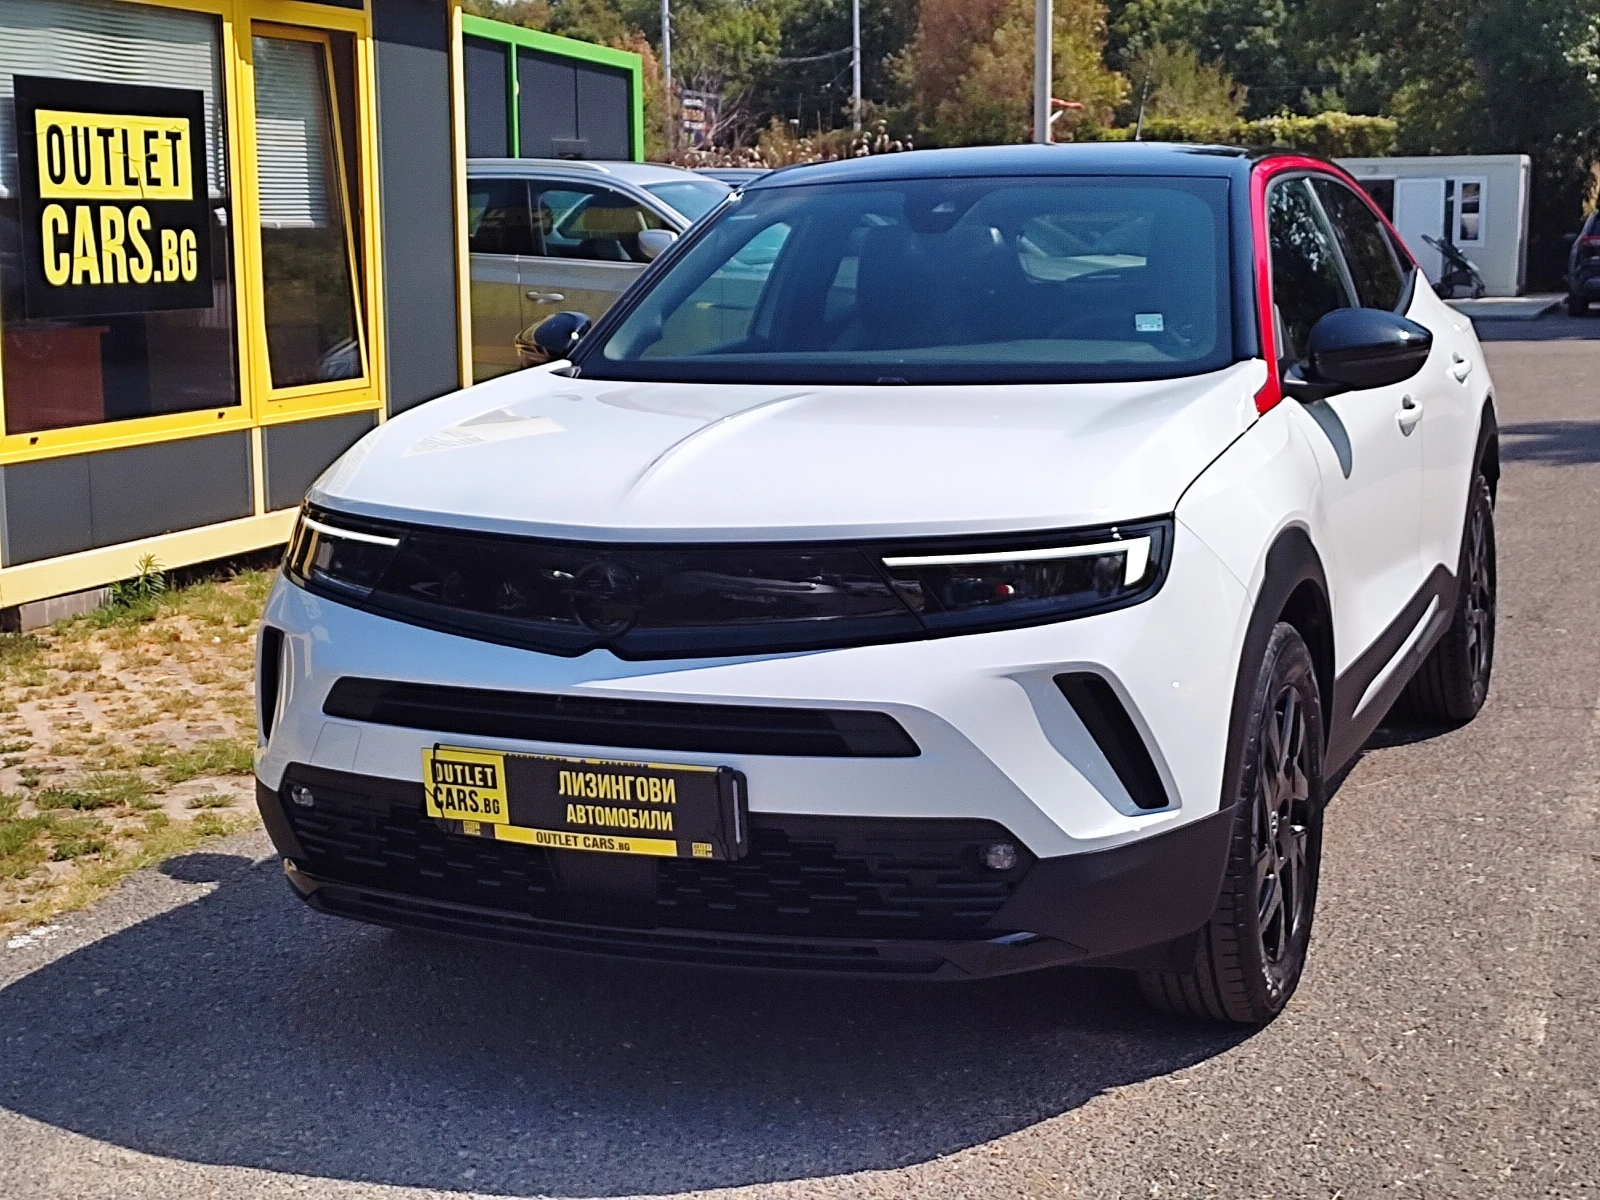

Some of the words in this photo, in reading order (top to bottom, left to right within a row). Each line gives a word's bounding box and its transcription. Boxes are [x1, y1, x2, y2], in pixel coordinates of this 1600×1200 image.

[46, 124, 182, 187] OUTLET
[42, 204, 198, 286] CARS.BG
[434, 763, 493, 786] OUTLET
[559, 771, 676, 804] ЛИЗИНГОВИ
[433, 786, 500, 814] CARS.BG
[567, 804, 673, 831] АВТОМОБИЛИ
[536, 831, 578, 847] OUTLET
[583, 836, 630, 851] CARS.BG
